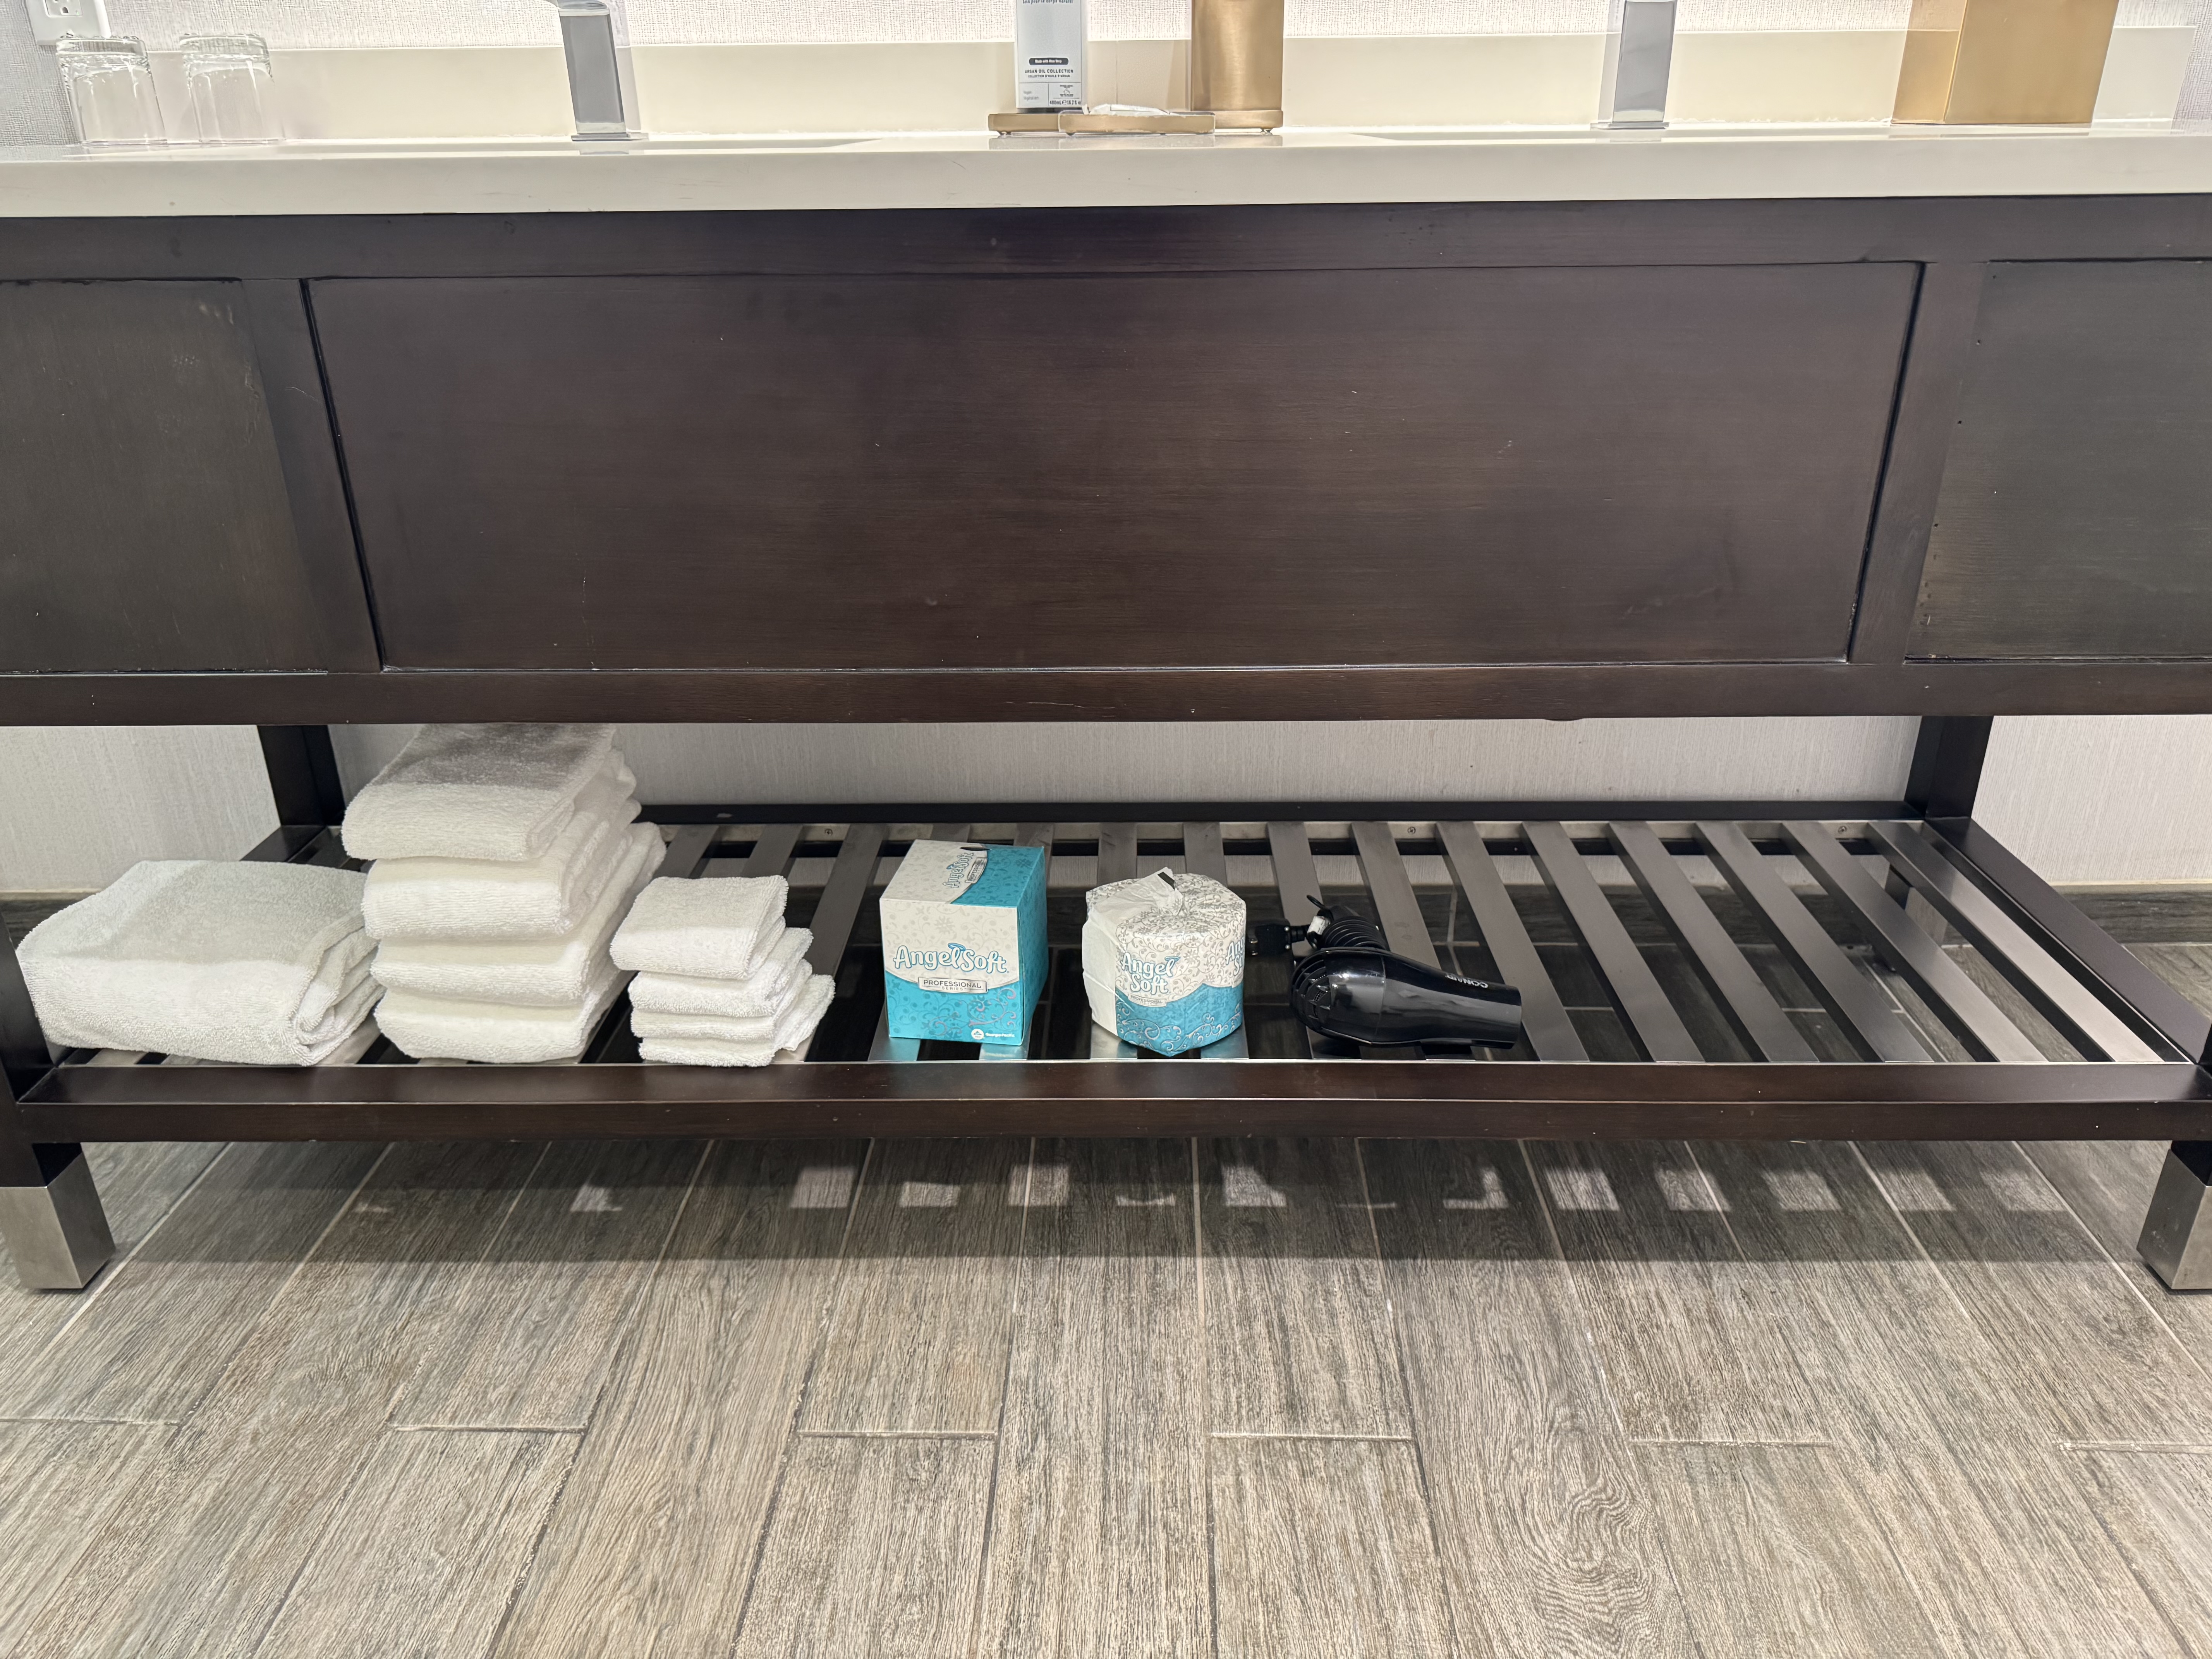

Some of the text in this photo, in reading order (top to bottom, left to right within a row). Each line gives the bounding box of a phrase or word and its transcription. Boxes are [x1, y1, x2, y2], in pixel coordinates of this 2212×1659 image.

[1121, 952, 1175, 979] Angel
[924, 979, 981, 988] PROFESSIONAL
[1130, 972, 1169, 995] Soft
[1131, 995, 1163, 1003] PROFESSIONAL
